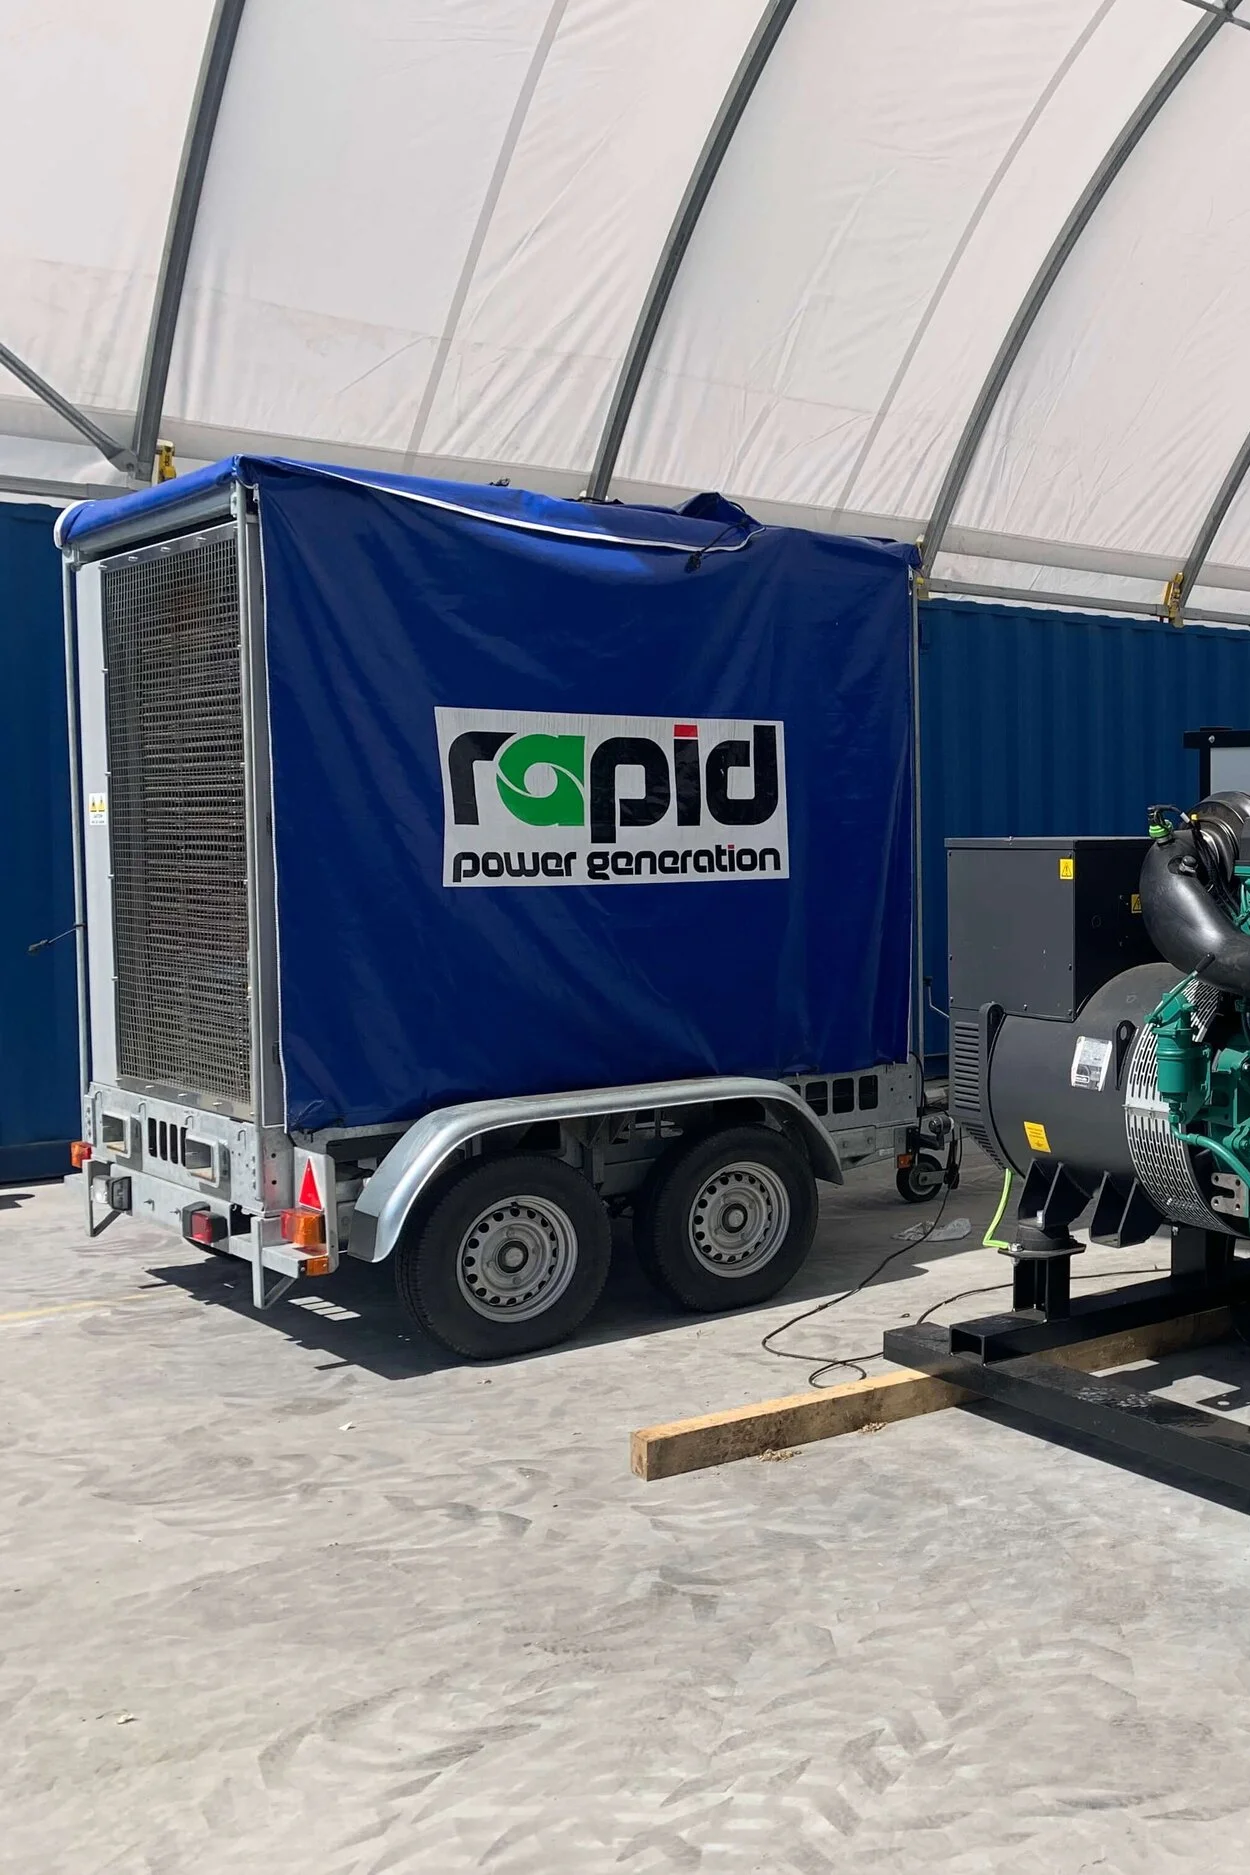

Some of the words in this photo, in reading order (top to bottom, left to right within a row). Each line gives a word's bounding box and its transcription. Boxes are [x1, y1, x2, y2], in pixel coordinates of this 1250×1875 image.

[448, 724, 779, 844] rapid
[452, 850, 577, 883] power
[586, 844, 781, 881] generation
